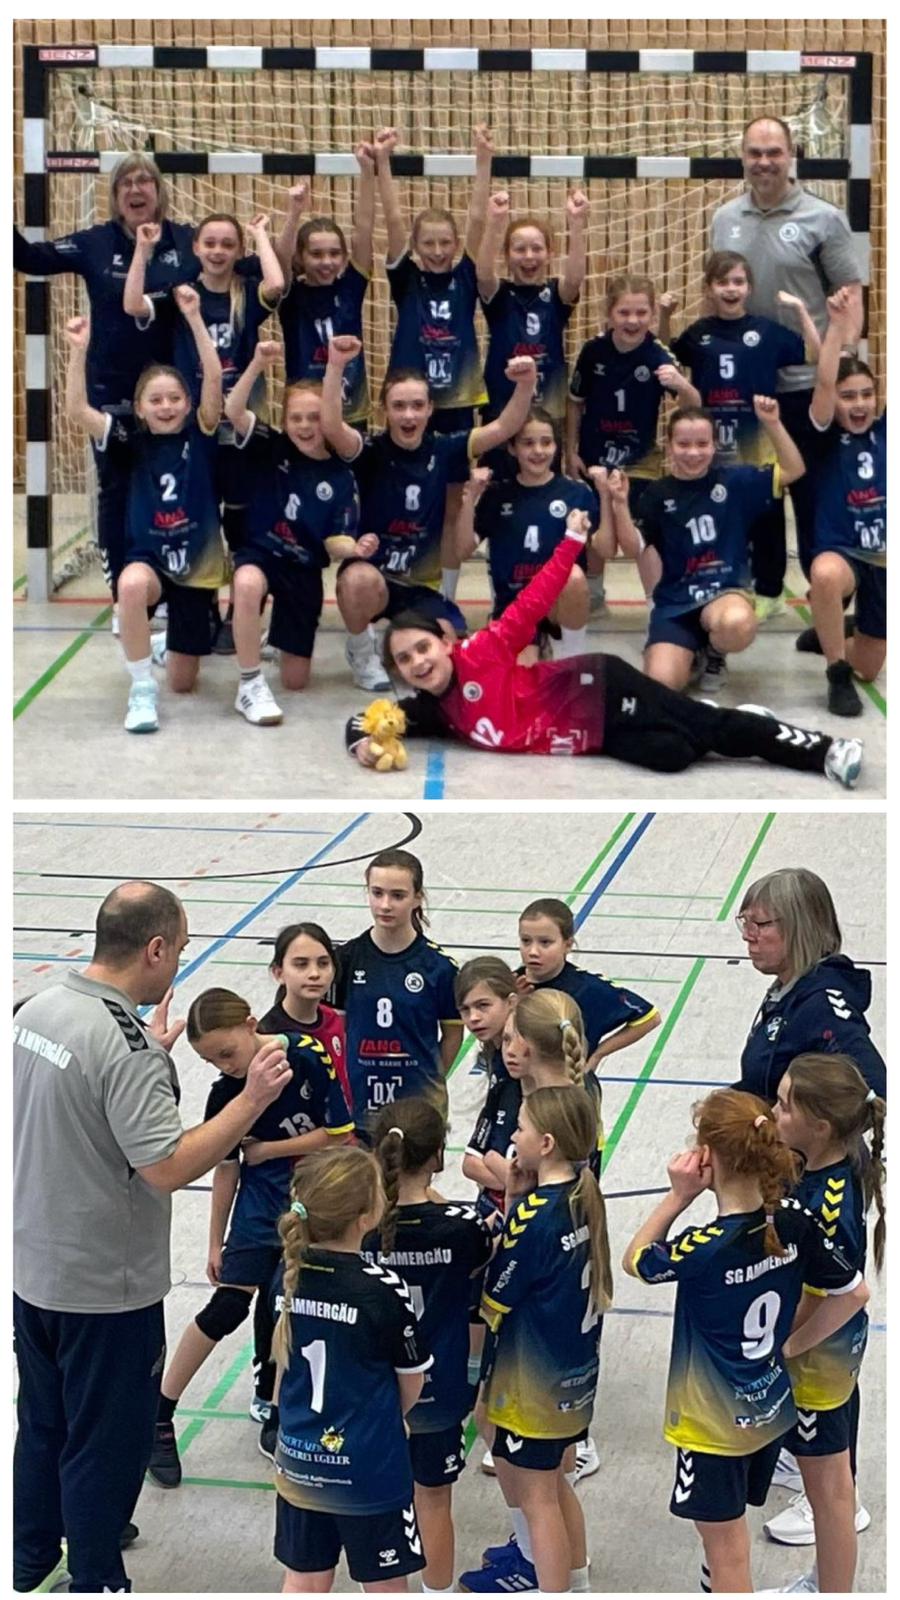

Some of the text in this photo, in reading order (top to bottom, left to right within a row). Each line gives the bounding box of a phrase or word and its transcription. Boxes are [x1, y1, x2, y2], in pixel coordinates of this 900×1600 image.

[208, 323, 232, 349] 13
[526, 312, 541, 336] 9
[719, 353, 735, 379] 5
[614, 388, 626, 412] 1
[857, 451, 874, 479] 3
[160, 472, 178, 502] 2
[405, 484, 421, 511] 8
[285, 493, 301, 521] 6
[524, 525, 540, 552] 4
[685, 514, 717, 545] 10
[470, 716, 505, 748] 12
[376, 997, 394, 1029] 8
[373, 1082, 396, 1105] QX
[279, 1112, 317, 1138] 13
[725, 1269, 744, 1285] SG
[741, 1290, 781, 1360] 9
[301, 1339, 326, 1414] 1
